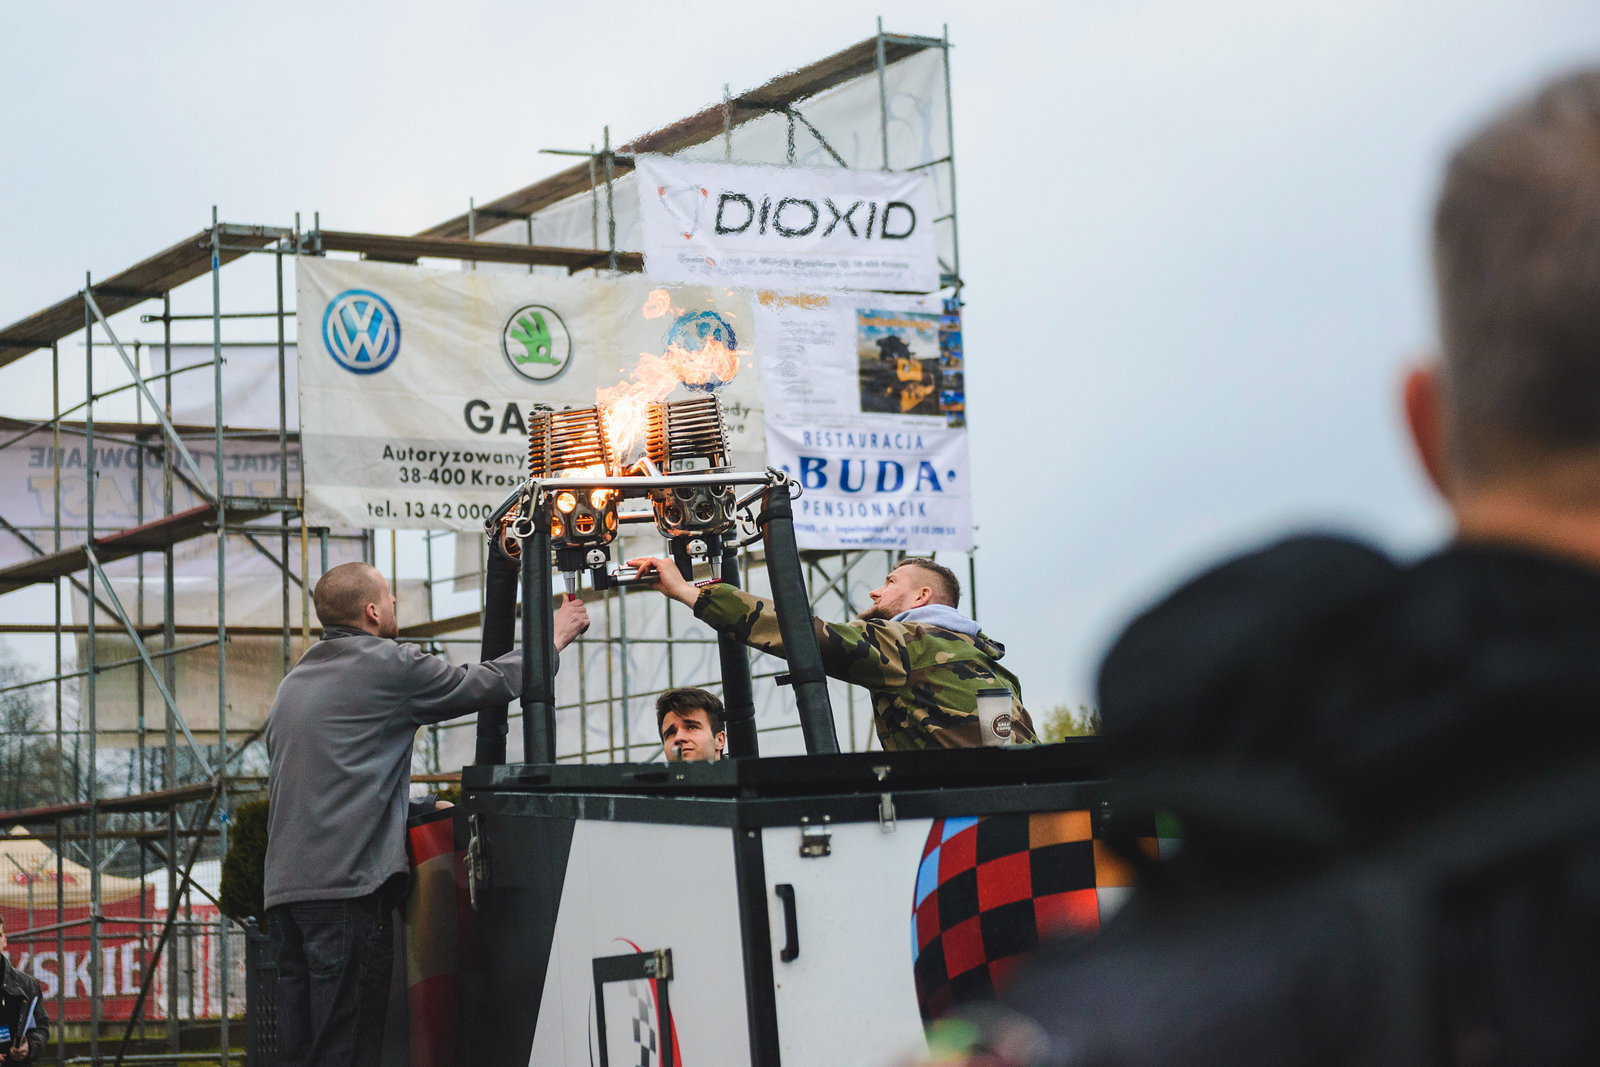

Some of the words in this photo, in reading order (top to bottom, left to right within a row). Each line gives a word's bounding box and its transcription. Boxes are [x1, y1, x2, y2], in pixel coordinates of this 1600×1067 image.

[715, 190, 916, 239] DIOXID
[464, 399, 528, 436] GA
[803, 431, 923, 449] RESTAURACJA
[382, 444, 526, 469] Autoryzowany
[399, 467, 466, 486] 38-400
[799, 456, 943, 493] BUDA
[367, 500, 397, 518] tel.
[404, 501, 425, 518] 13
[430, 503, 452, 519] 42
[802, 501, 926, 518] PENSJONACIK
